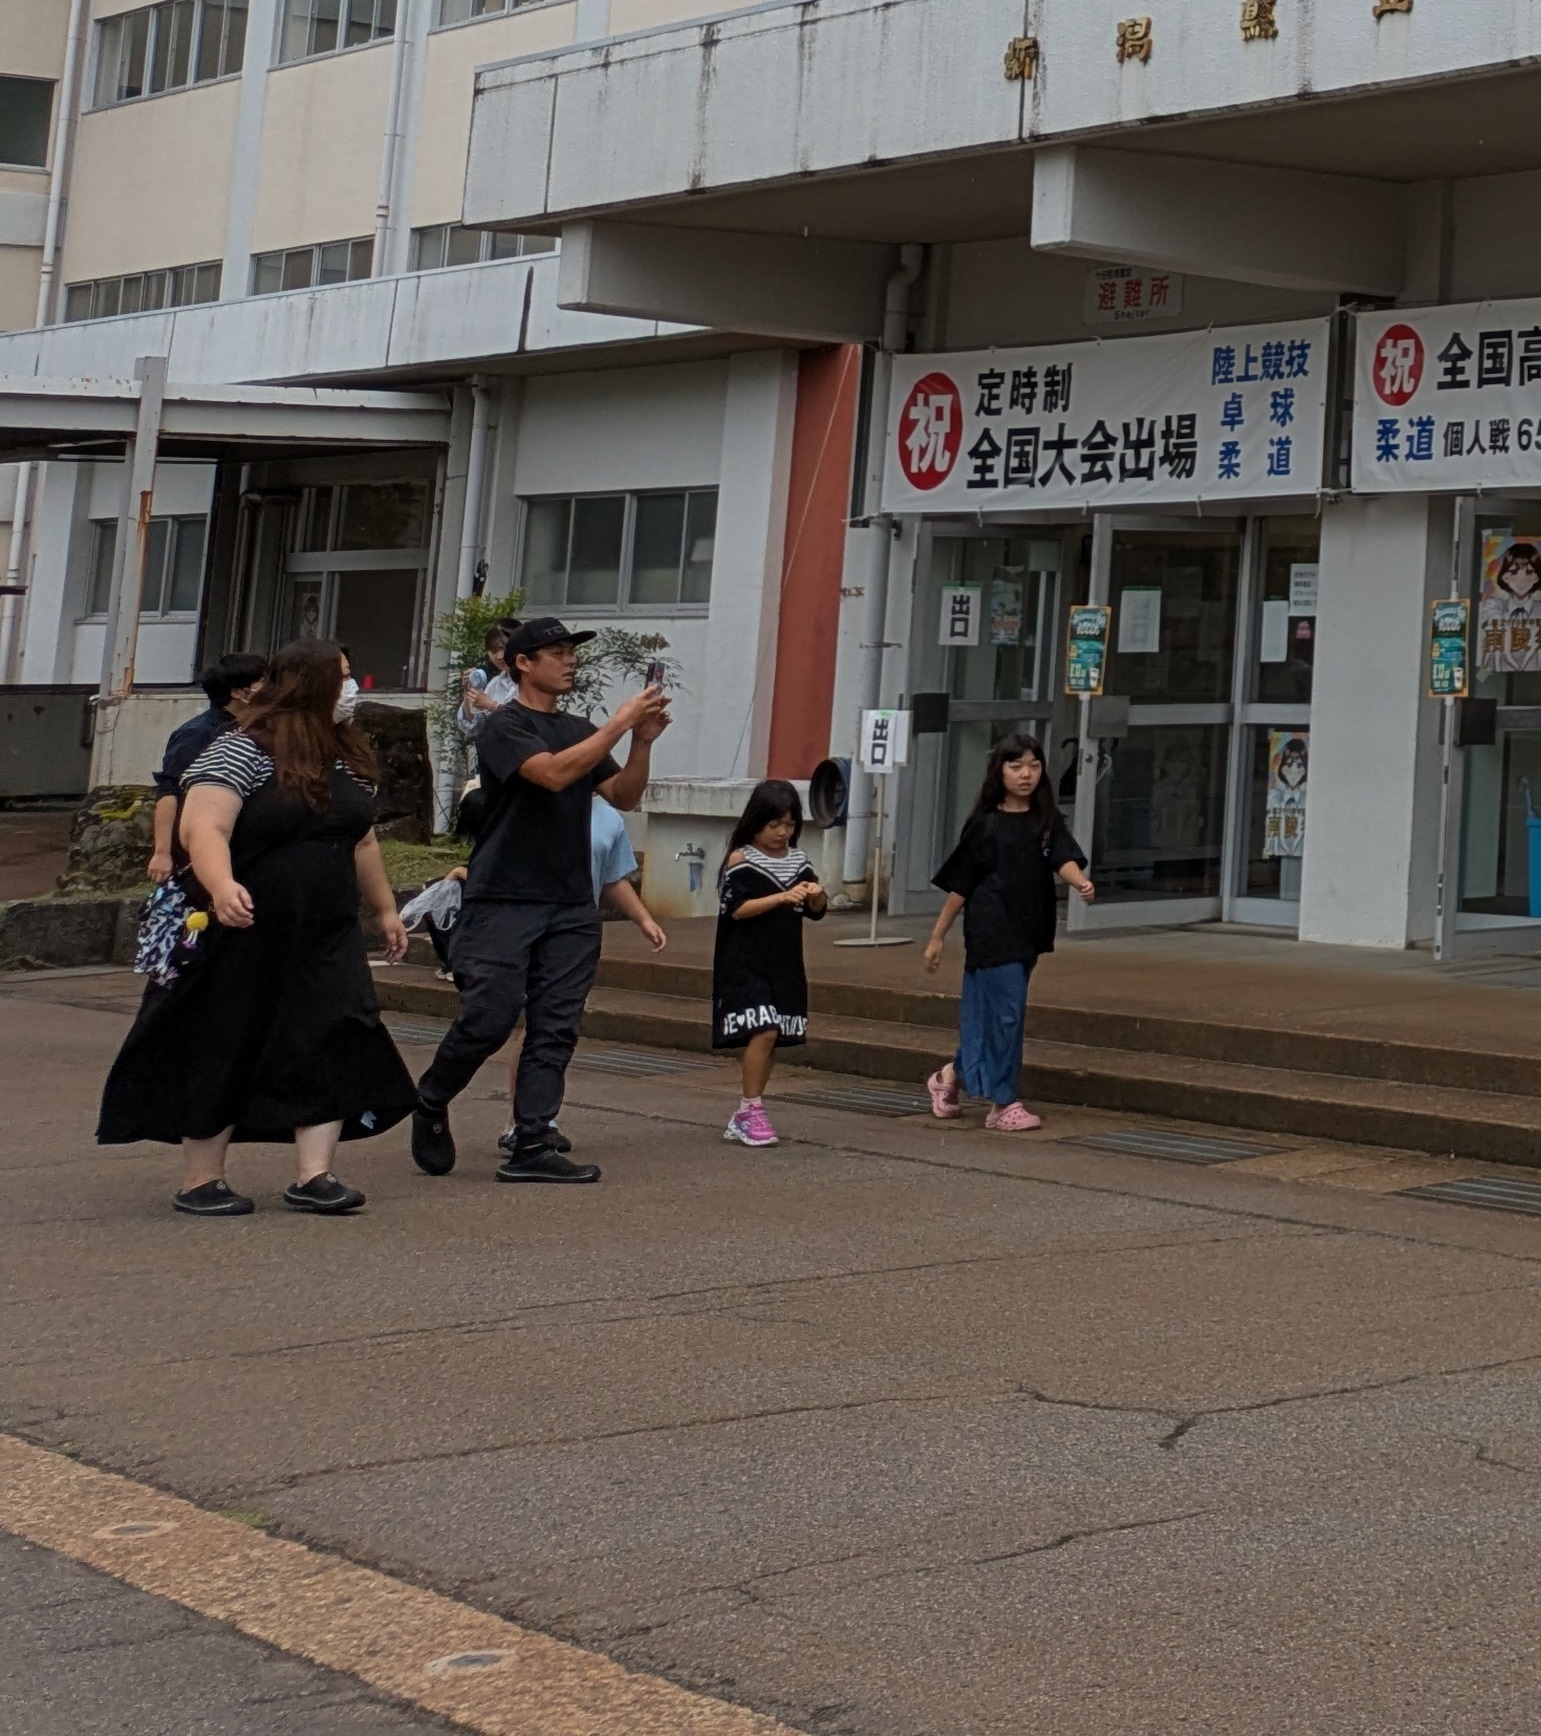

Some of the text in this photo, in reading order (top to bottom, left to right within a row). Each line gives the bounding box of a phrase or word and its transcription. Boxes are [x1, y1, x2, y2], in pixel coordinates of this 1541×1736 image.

[1097, 275, 1171, 311] 避難所
[1211, 339, 1313, 386] 陸上競技
[1379, 336, 1417, 396] 祝
[975, 363, 1074, 417] 定時制
[905, 393, 953, 475] 祝
[966, 413, 1199, 490] 全国大会出場
[1376, 416, 1435, 463] 柔道
[1443, 418, 1511, 458] 個人戦
[951, 594, 970, 638] 出口
[871, 718, 889, 765] 出口
